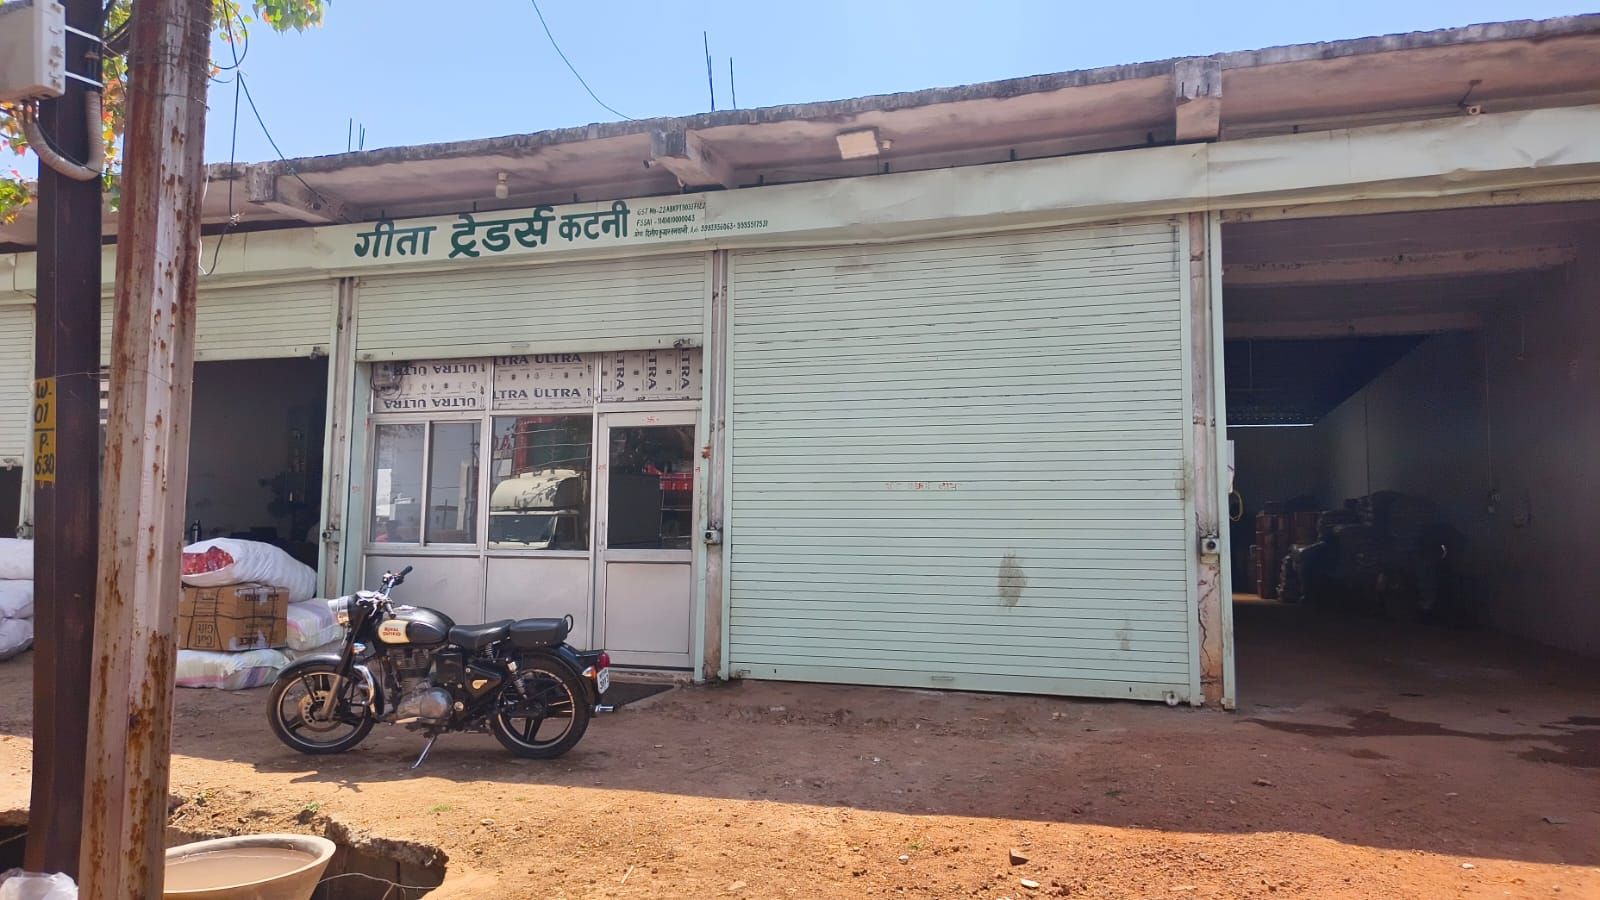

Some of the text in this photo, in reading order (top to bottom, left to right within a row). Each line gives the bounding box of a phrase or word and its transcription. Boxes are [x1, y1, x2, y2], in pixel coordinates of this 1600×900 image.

[637, 207, 648, 216] GST
[354, 200, 630, 259] गीता ट्रेडर्स कटनी
[34, 402, 49, 425] 01
